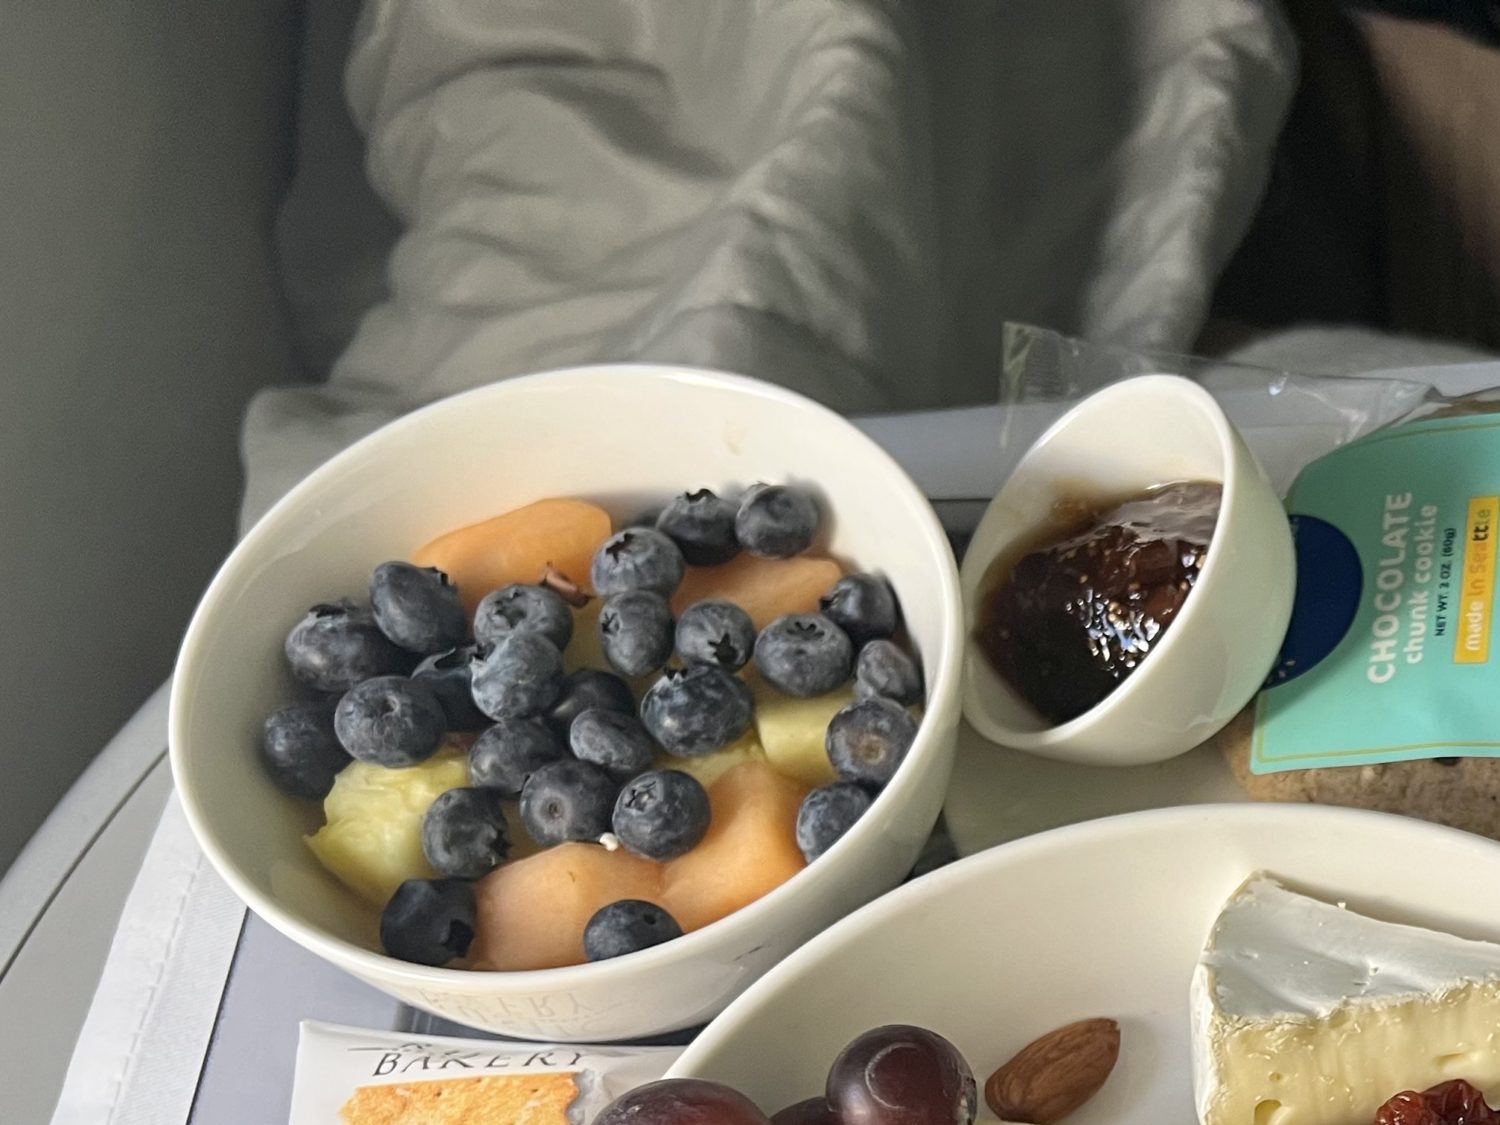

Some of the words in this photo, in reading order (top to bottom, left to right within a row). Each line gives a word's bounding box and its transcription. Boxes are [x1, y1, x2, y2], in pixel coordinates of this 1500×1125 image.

[1414, 504, 1437, 583] cookie
[1471, 509, 1491, 573] Seattle
[1367, 491, 1412, 684] CHOCOLATE
[1403, 590, 1429, 664] chunk
[1434, 614, 1446, 636] NET
[1465, 601, 1482, 651] made
